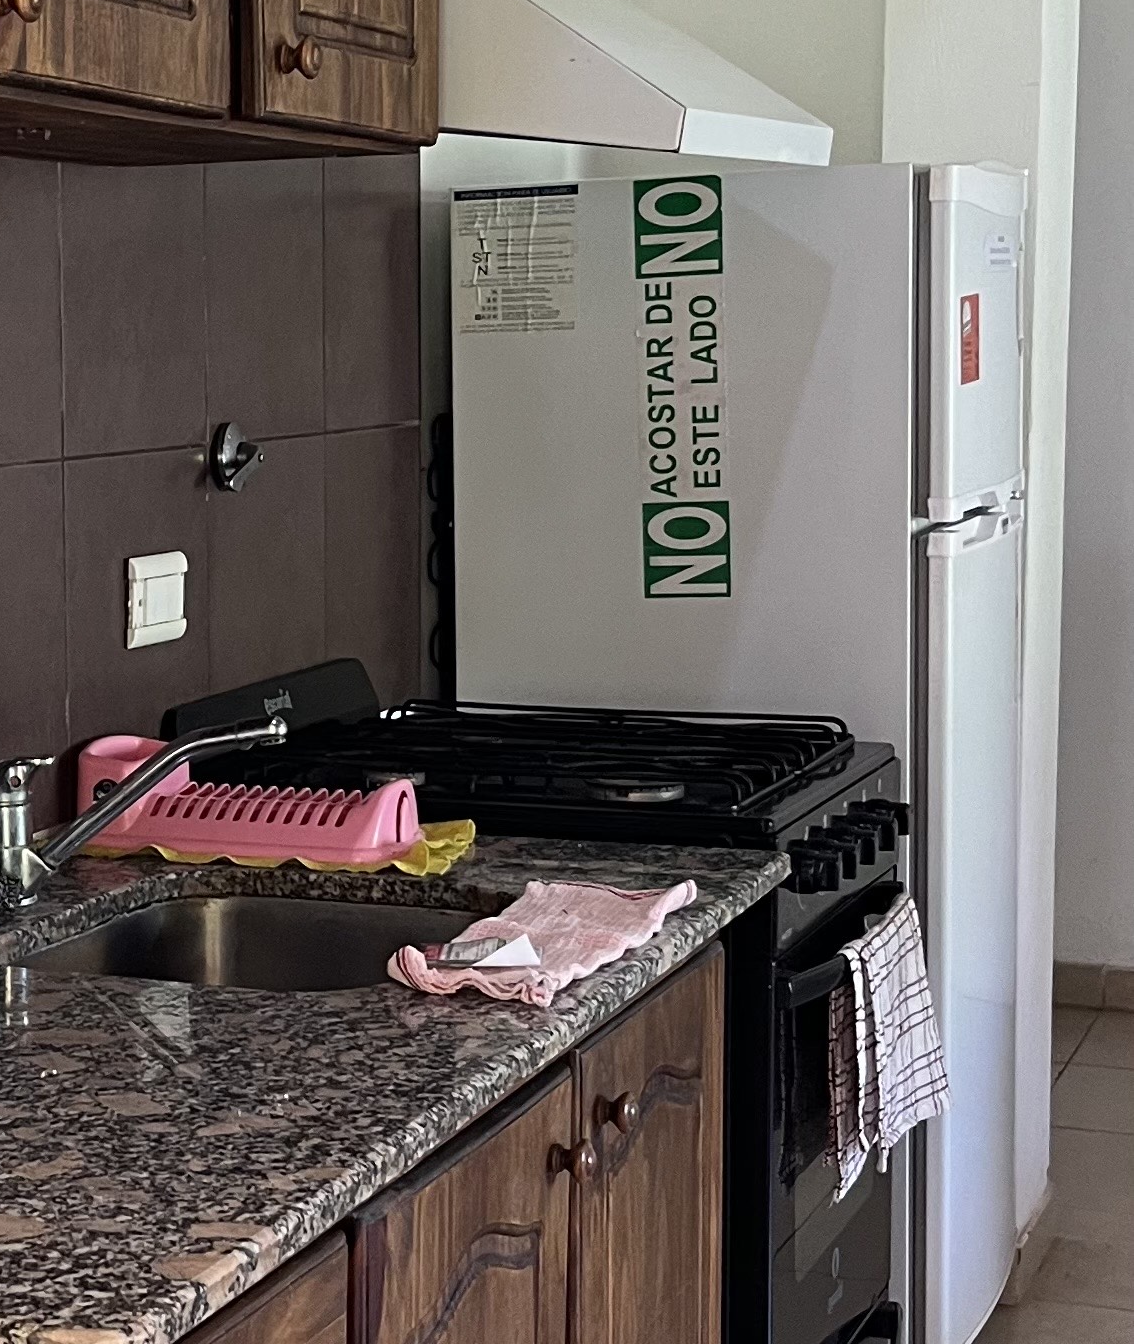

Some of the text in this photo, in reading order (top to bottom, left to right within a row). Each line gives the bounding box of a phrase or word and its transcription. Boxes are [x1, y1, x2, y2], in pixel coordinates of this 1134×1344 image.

[638, 181, 719, 275] NO
[644, 281, 678, 497] ACOSTAR DE
[688, 295, 721, 488] ESTE LADO
[646, 506, 727, 595] NO
